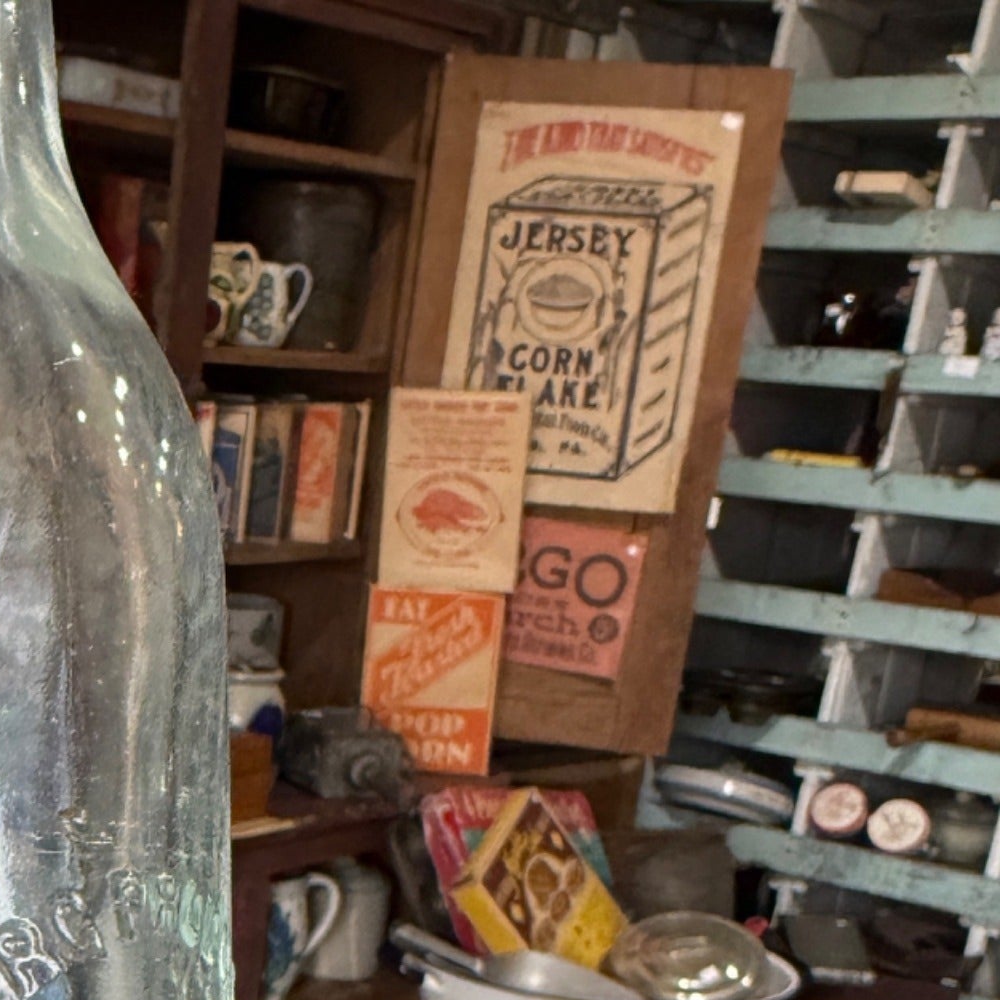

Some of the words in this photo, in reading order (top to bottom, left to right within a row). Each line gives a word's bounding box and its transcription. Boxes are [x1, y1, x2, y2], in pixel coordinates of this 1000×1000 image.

[499, 220, 637, 258] JERSEY
[508, 343, 594, 378] CORN
[518, 543, 629, 609] GO
[408, 740, 473, 767] RN
